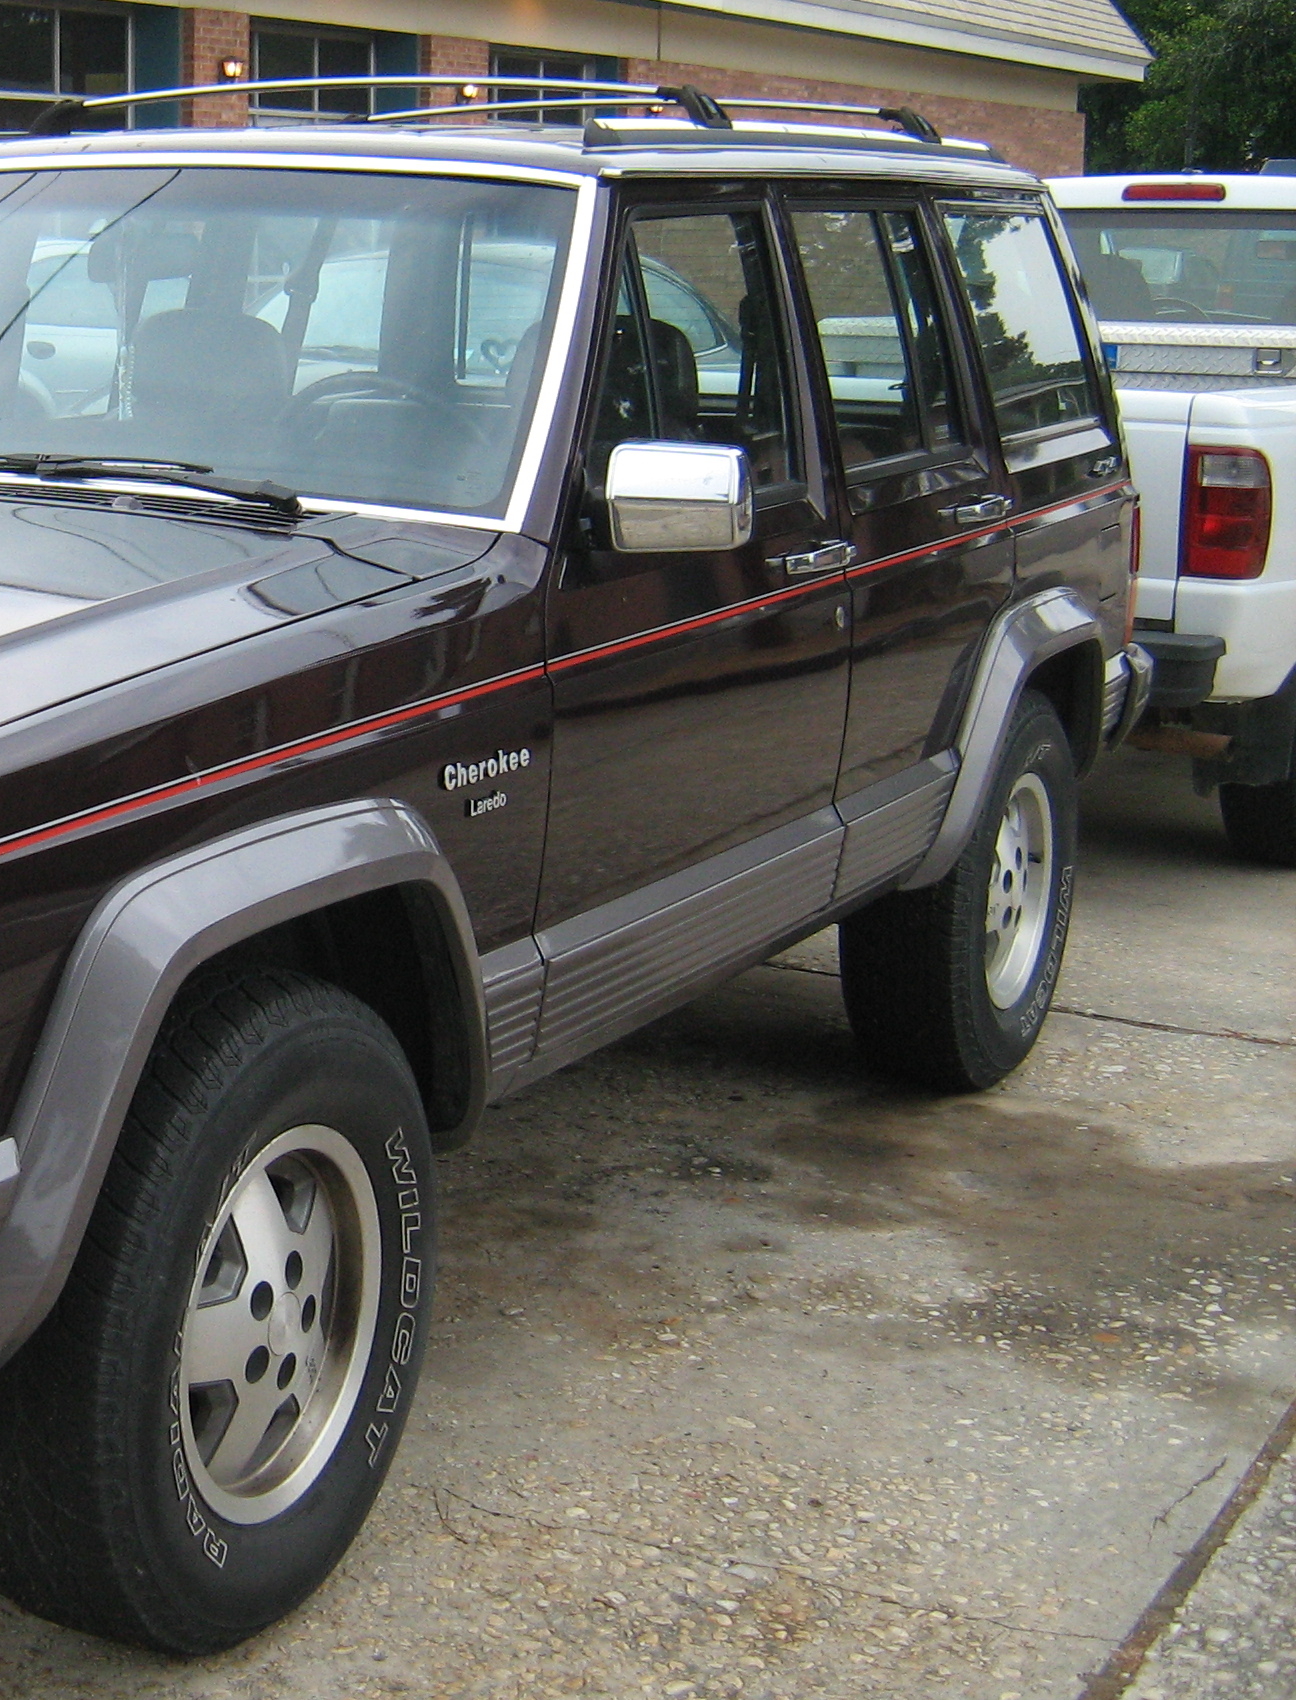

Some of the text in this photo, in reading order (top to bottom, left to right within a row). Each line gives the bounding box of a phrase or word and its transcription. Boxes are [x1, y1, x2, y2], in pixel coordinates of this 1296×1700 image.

[443, 748, 531, 791] Cherokee
[469, 791, 507, 817] Laredo
[1019, 865, 1073, 1037] WILDCAT
[365, 1126, 422, 1468] WILDCAT
